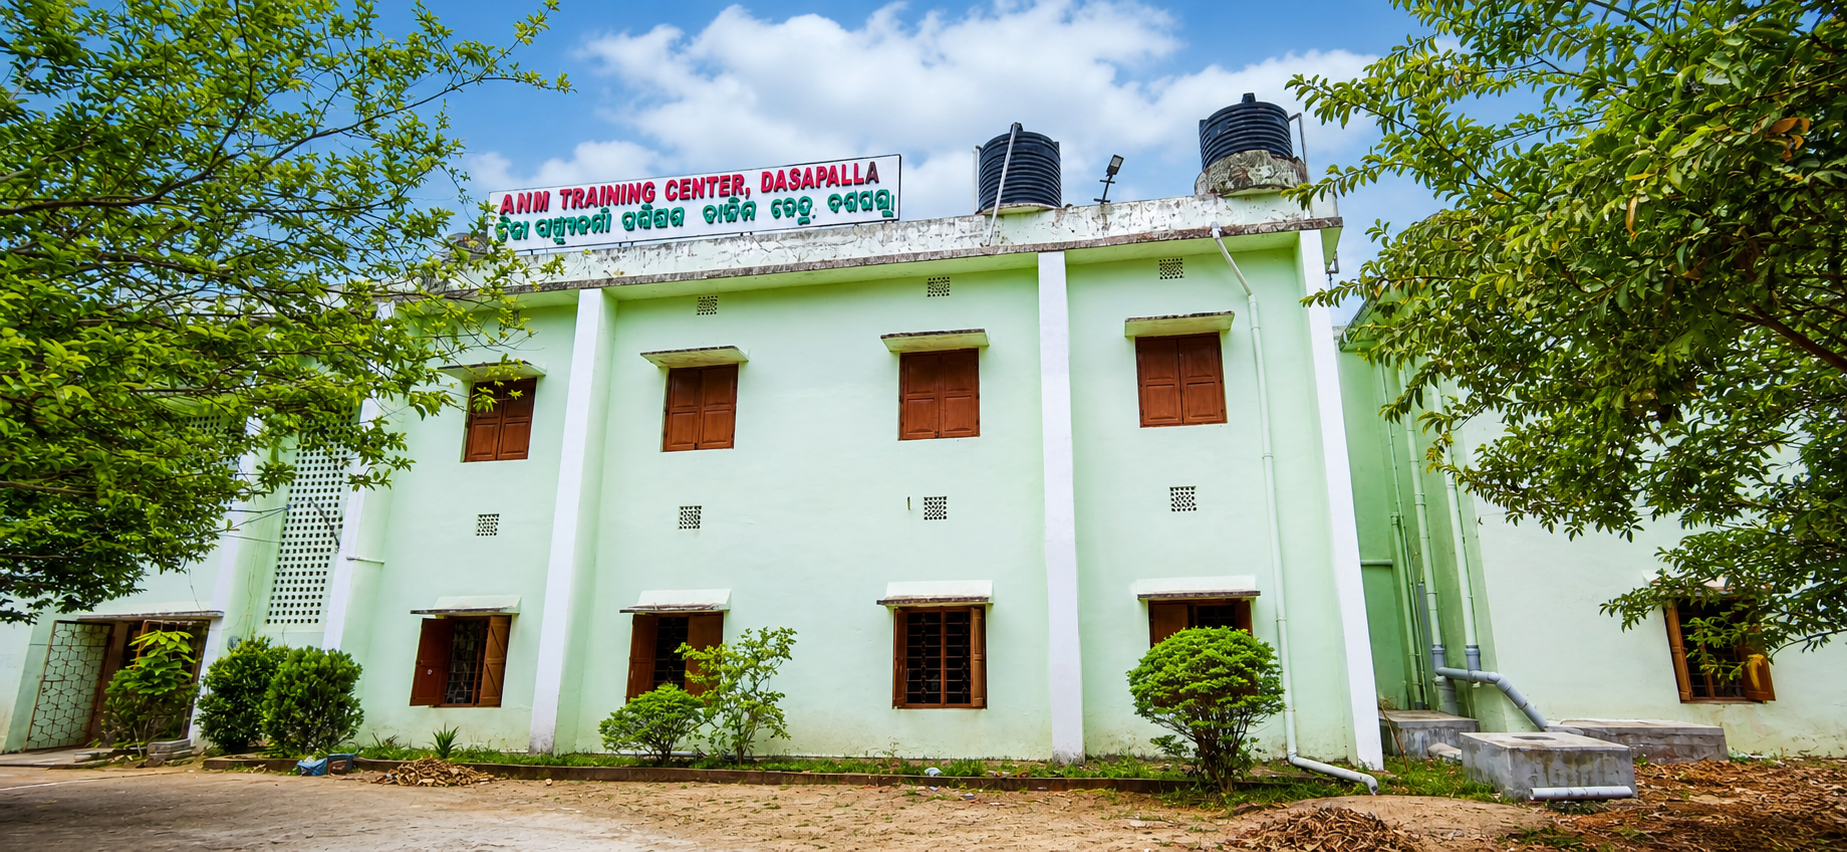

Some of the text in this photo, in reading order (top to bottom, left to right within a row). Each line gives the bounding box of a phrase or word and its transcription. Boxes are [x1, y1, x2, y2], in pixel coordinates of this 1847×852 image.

[500, 161, 880, 215] ANM TRAINING CENTER, DASAPALLA
